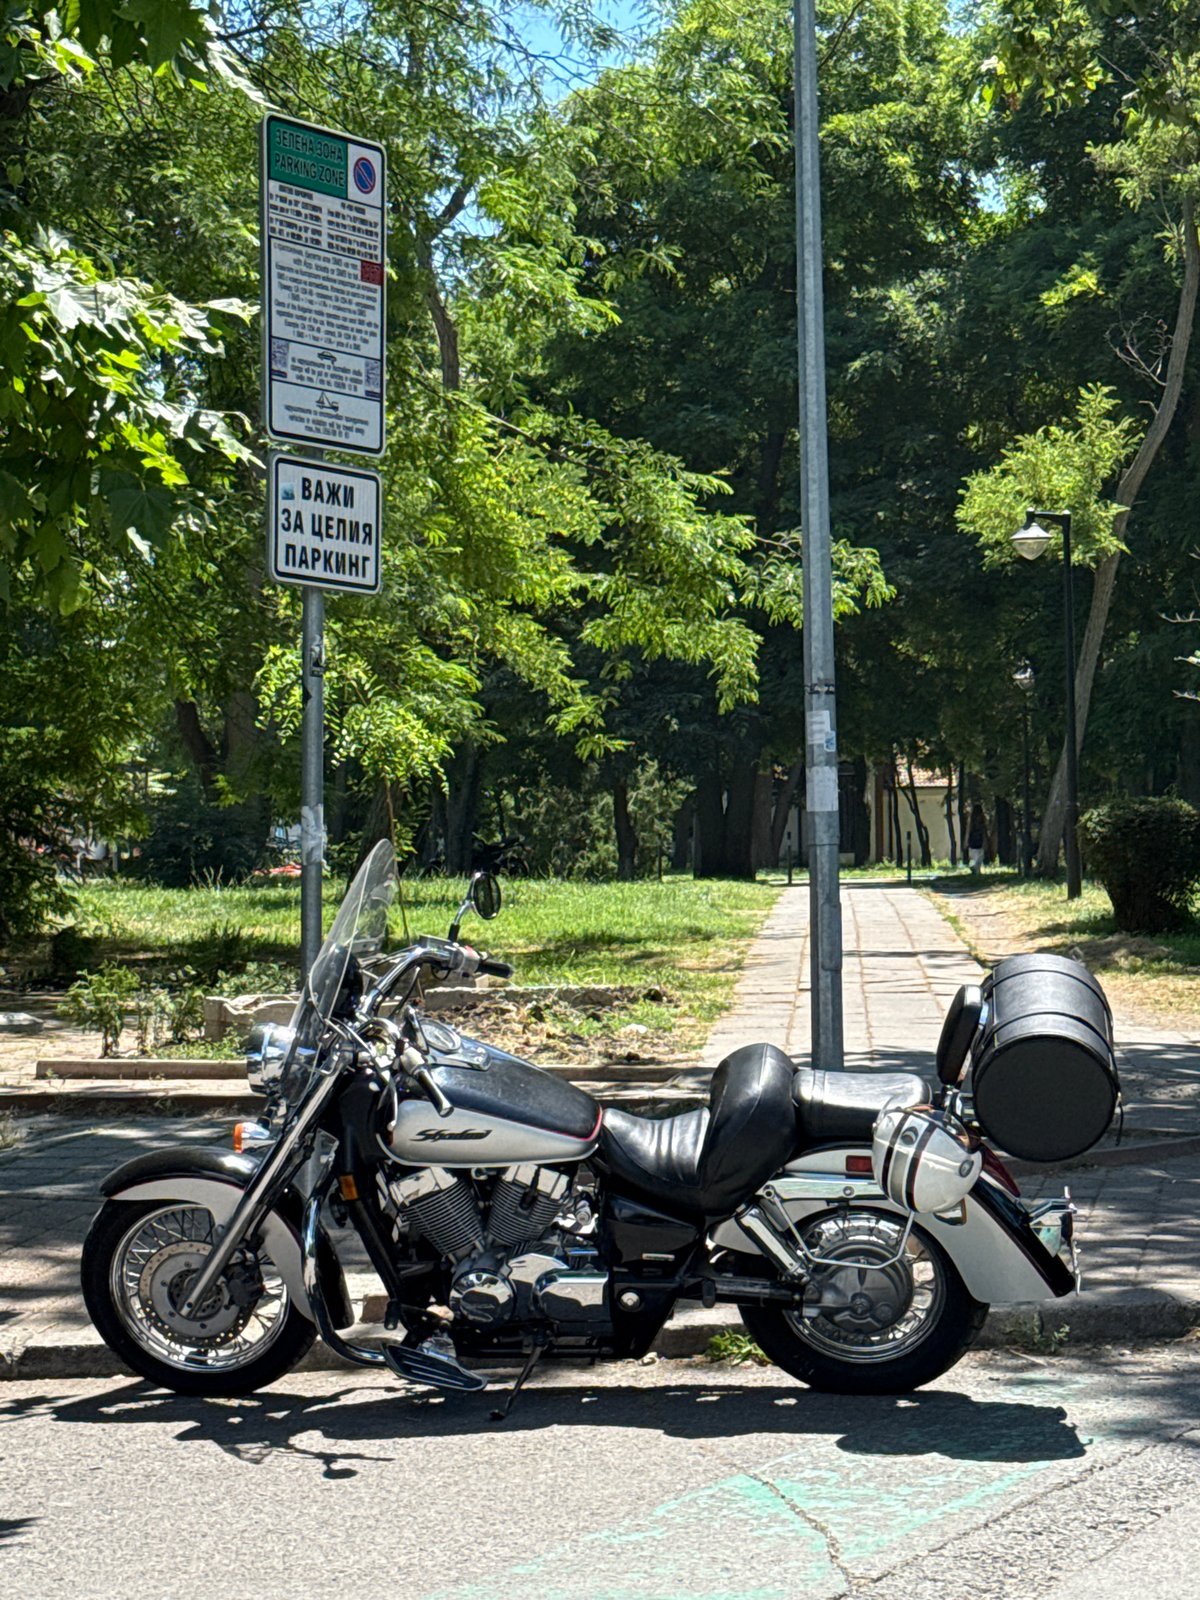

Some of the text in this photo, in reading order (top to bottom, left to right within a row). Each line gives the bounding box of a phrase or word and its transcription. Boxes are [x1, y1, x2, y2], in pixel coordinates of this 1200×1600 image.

[275, 128, 344, 164] ЗЕЛЕНА ЗОНА
[274, 152, 345, 188] PARKING ZONE
[301, 477, 355, 509] ВАЖИ
[281, 508, 372, 546] ЗА ЦЕЛИЯ
[284, 543, 371, 578] ПАРКИНГ
